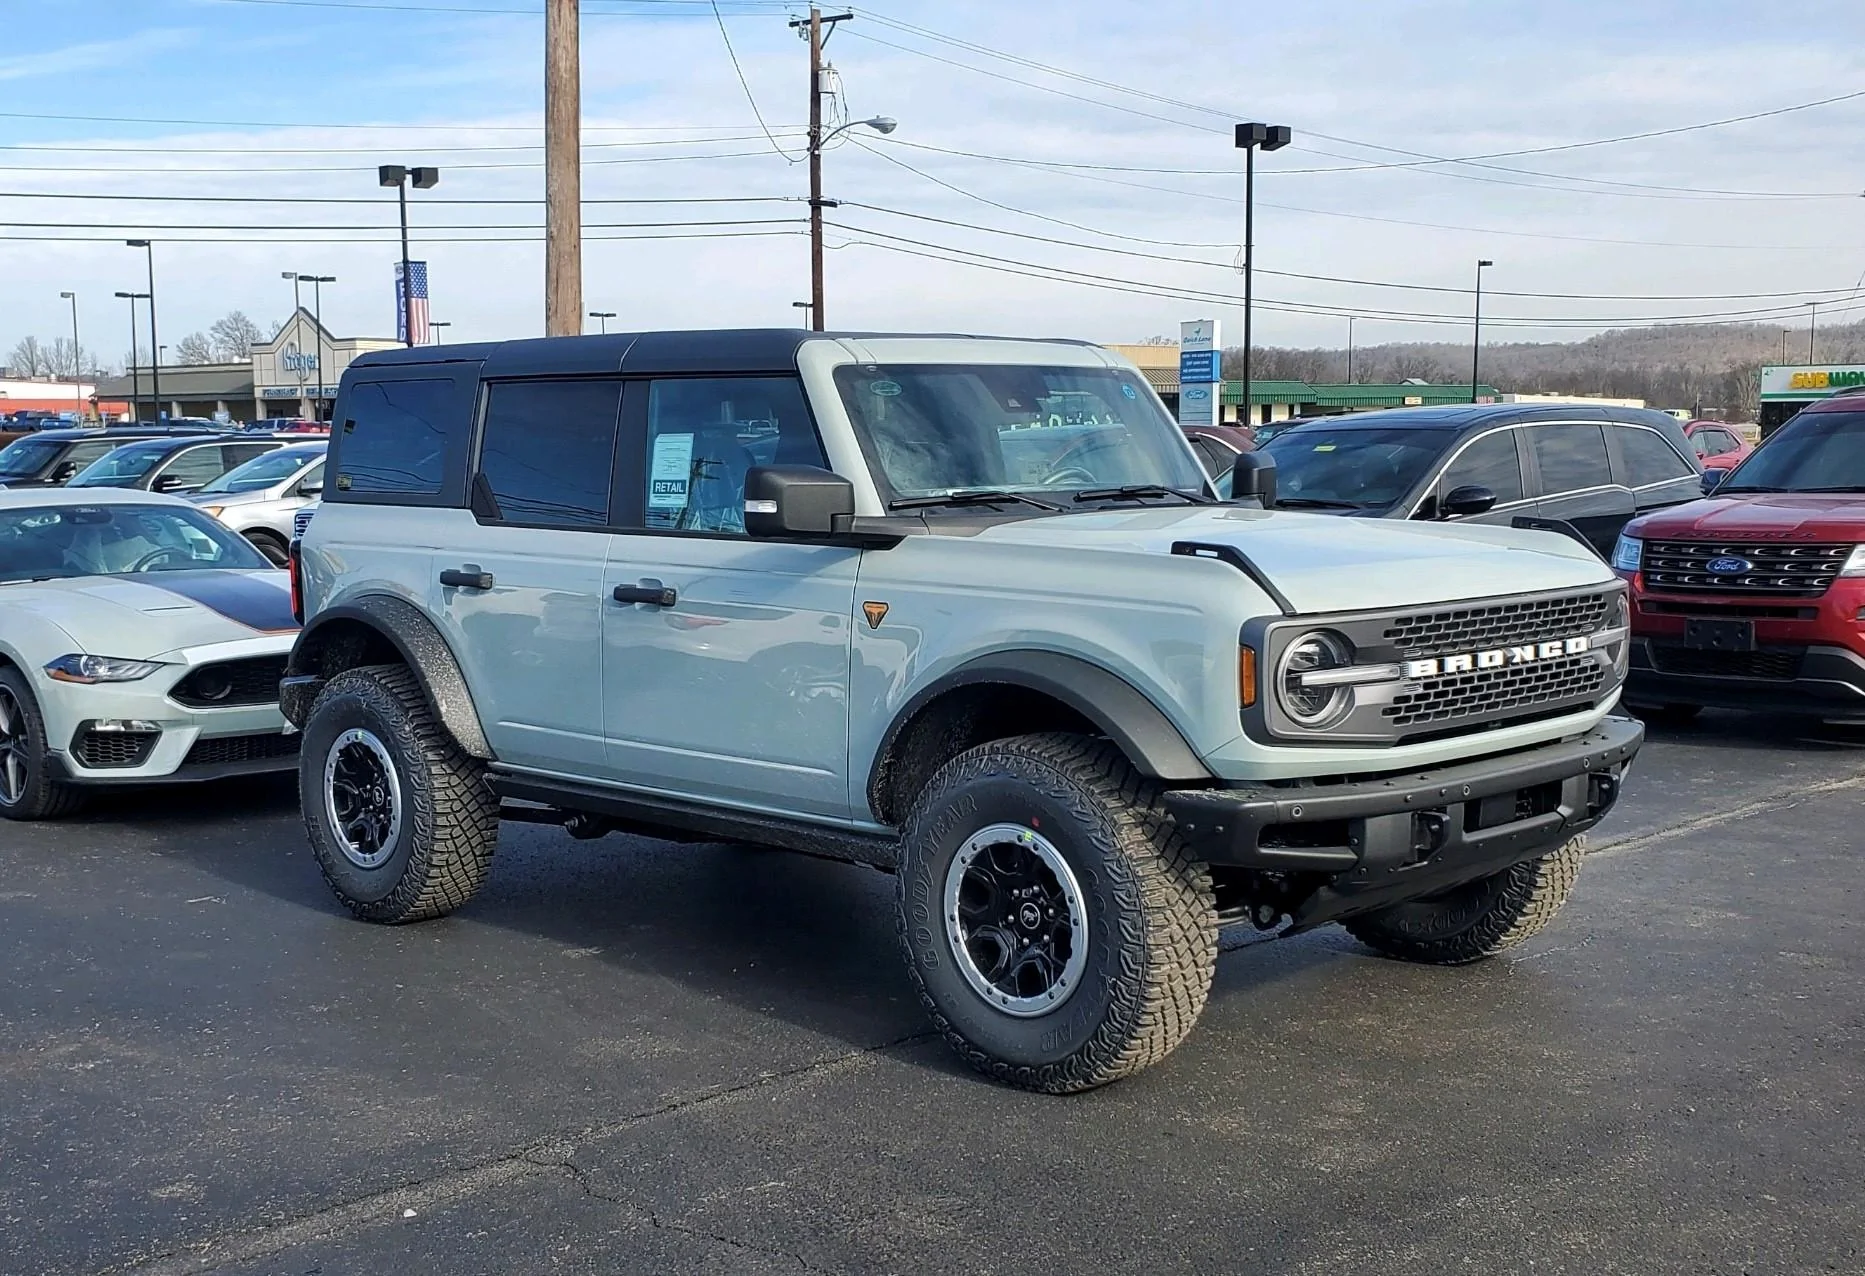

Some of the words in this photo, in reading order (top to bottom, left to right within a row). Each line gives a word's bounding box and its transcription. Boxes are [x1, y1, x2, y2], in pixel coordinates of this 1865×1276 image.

[399, 281, 407, 341] FORD
[283, 341, 319, 381] Kroger
[1188, 390, 1205, 399] Ford
[655, 481, 684, 493] RETAIL
[1714, 559, 1742, 571] Ford
[1407, 636, 1589, 678] BRONCO
[912, 792, 978, 970] GOODYEAR
